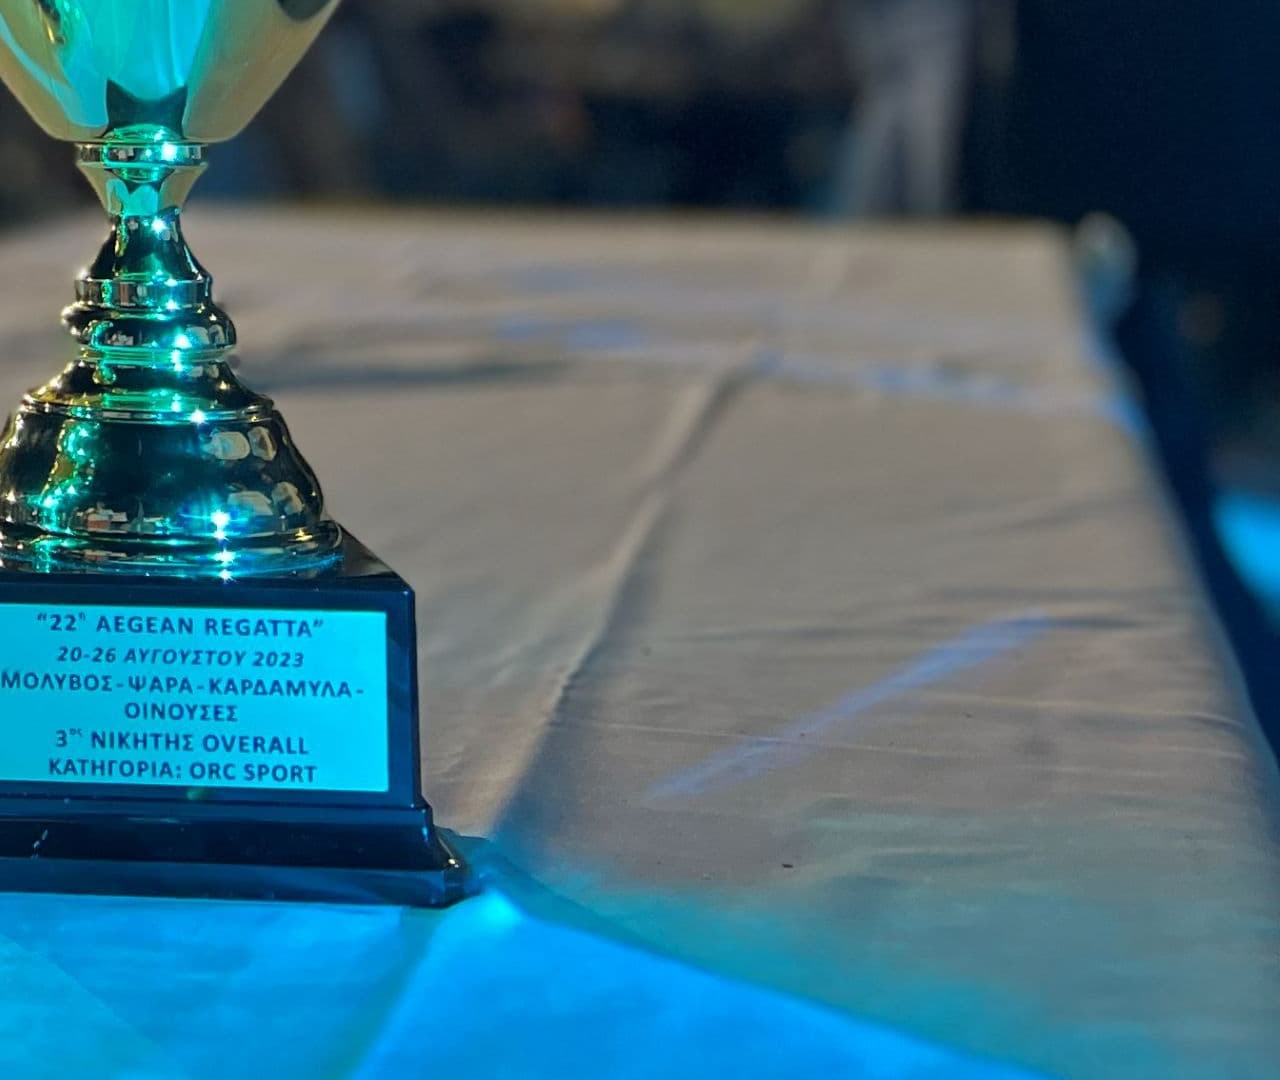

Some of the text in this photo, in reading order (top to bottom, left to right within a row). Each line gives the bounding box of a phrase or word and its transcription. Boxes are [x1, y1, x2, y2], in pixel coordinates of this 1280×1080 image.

[96, 615, 194, 634] AEGEAN
[56, 646, 305, 668] 20-26 ΑΥΓΟΥΣΤΟΥ 2023
[124, 702, 239, 722] ΟΙΝΟΥΣΕΣ
[91, 731, 194, 752] ΝΙΚΗΤΗΣ
[202, 733, 310, 755] OVERALL
[48, 758, 318, 783] ΚΑΤΗΓΟΡΙΑ: ORC SPORT
